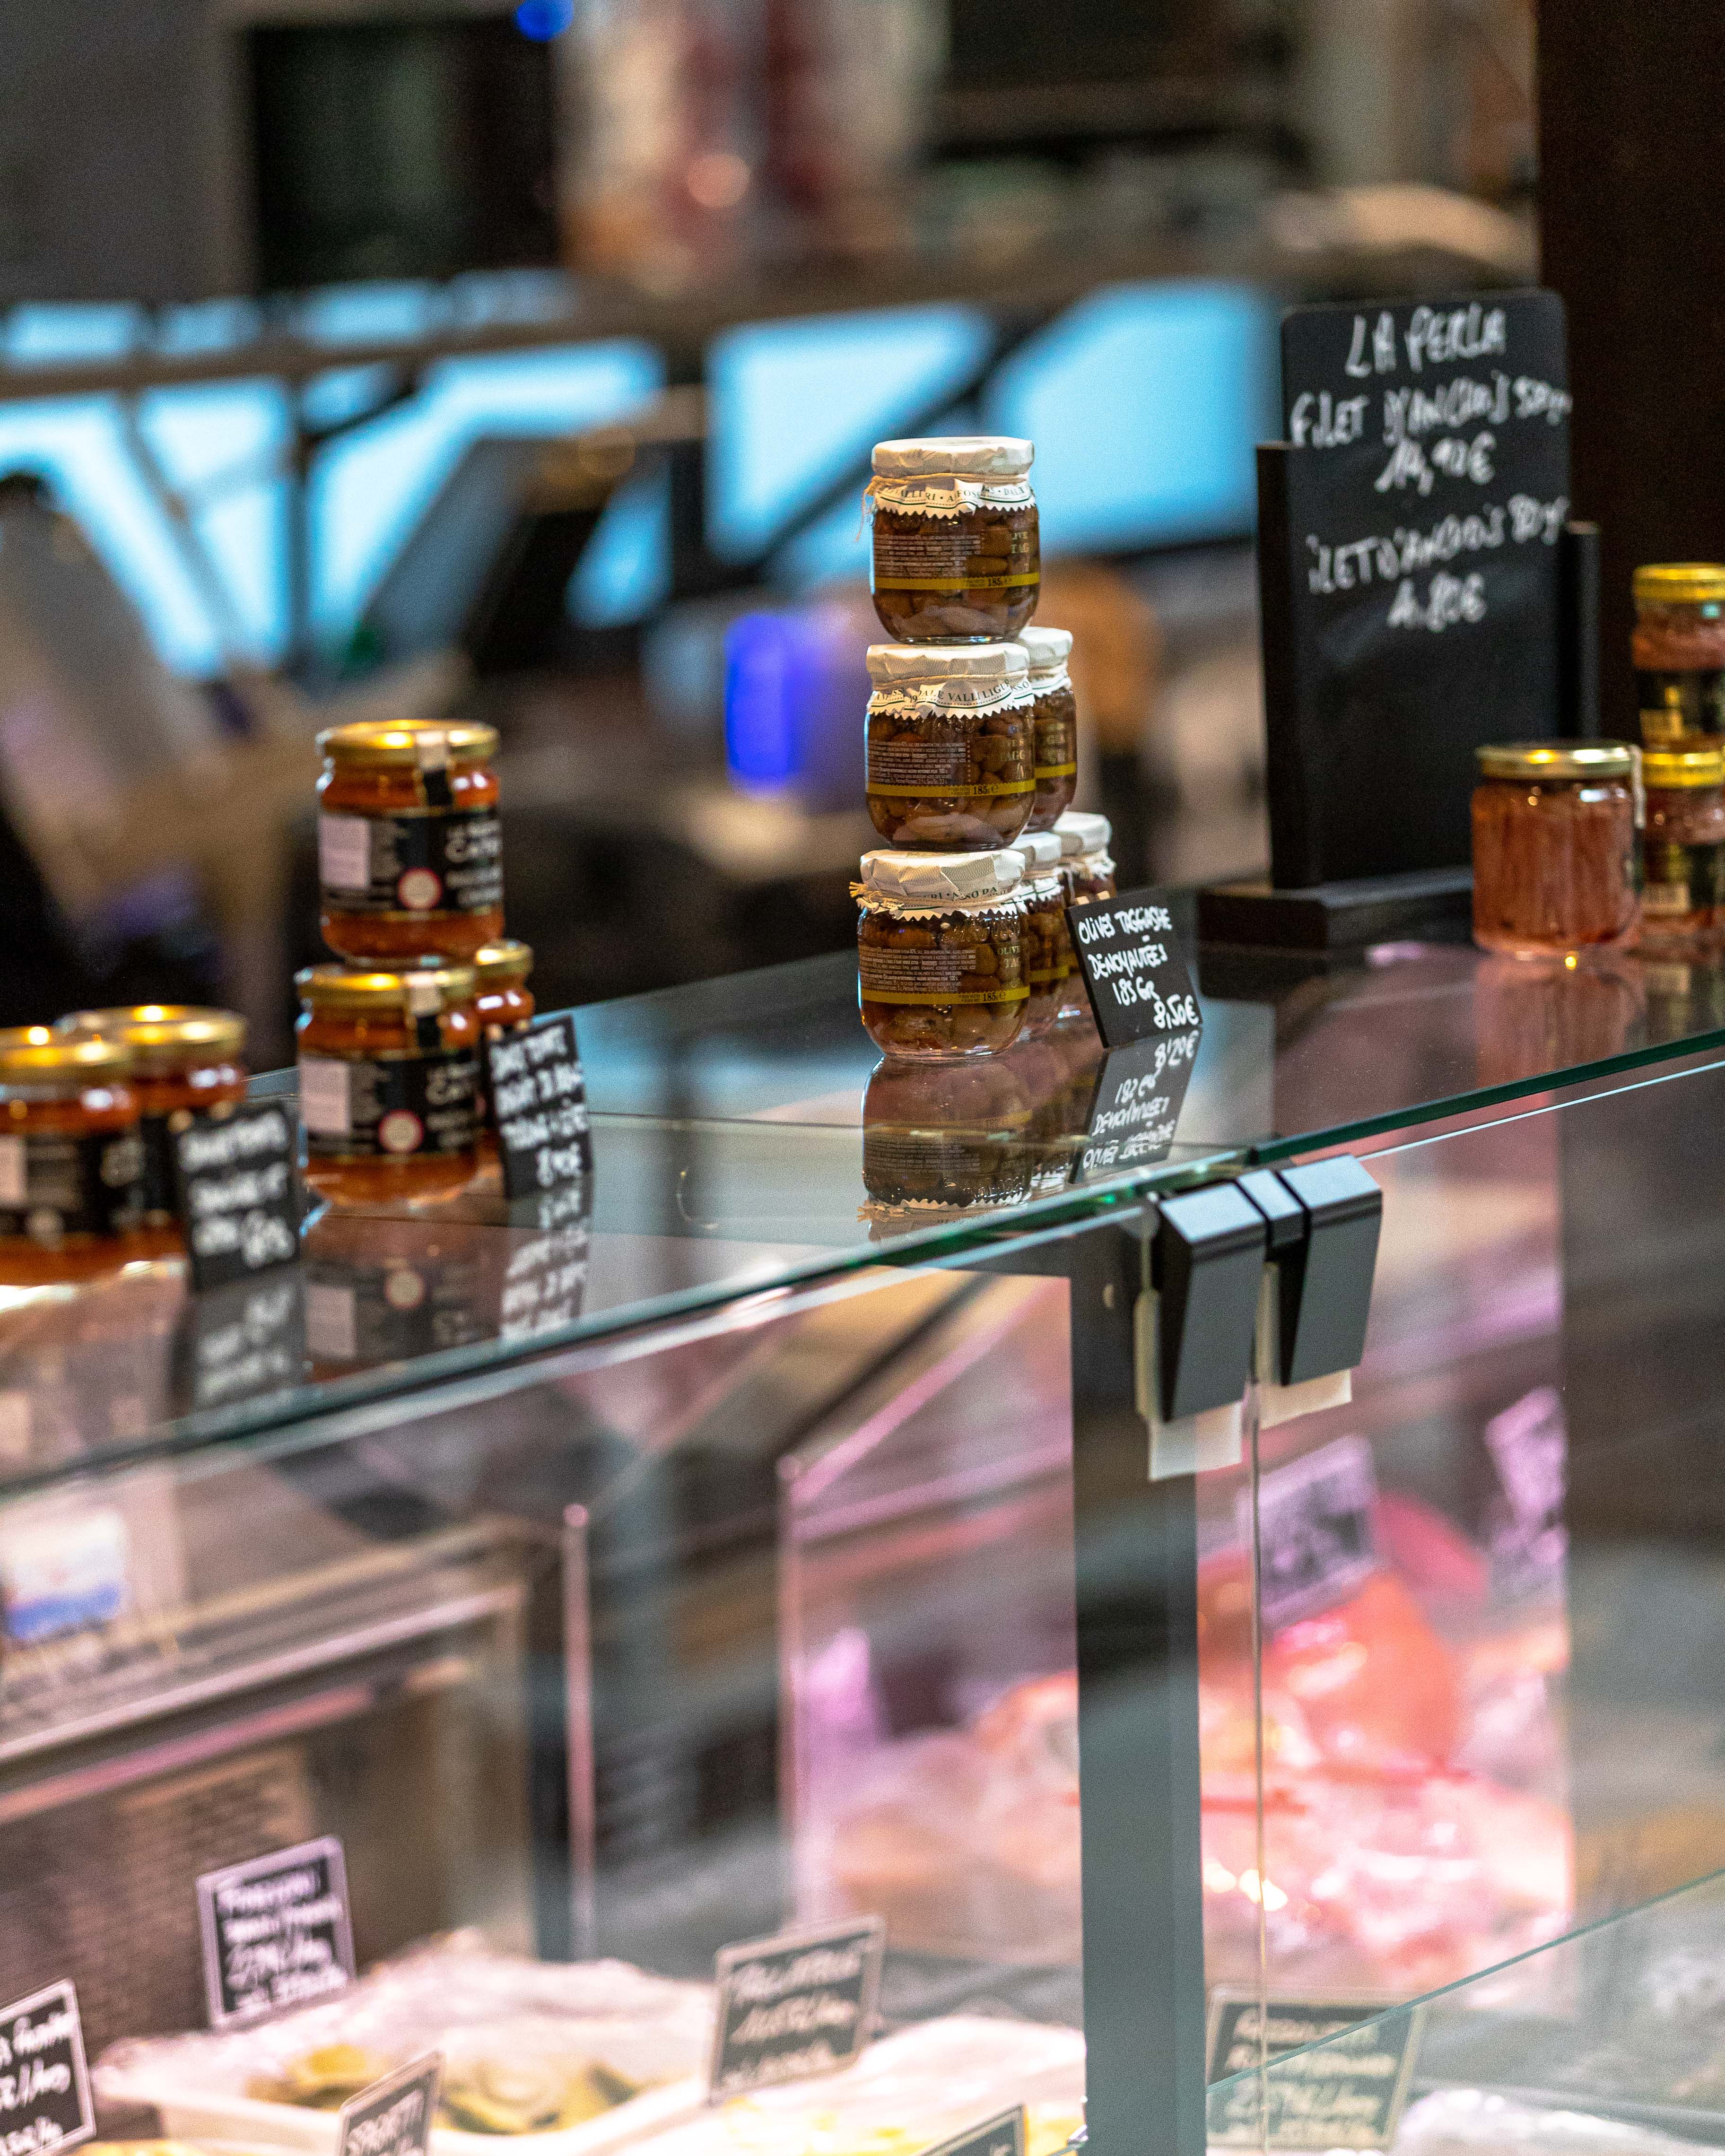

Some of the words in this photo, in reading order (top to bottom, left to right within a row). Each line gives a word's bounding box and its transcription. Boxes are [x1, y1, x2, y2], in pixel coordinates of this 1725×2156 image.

[1345, 313, 1396, 378] LA
[1405, 302, 1506, 373] PERLA
[1112, 978, 1137, 1006] 185
[1153, 993, 1199, 1029] 8,50€
